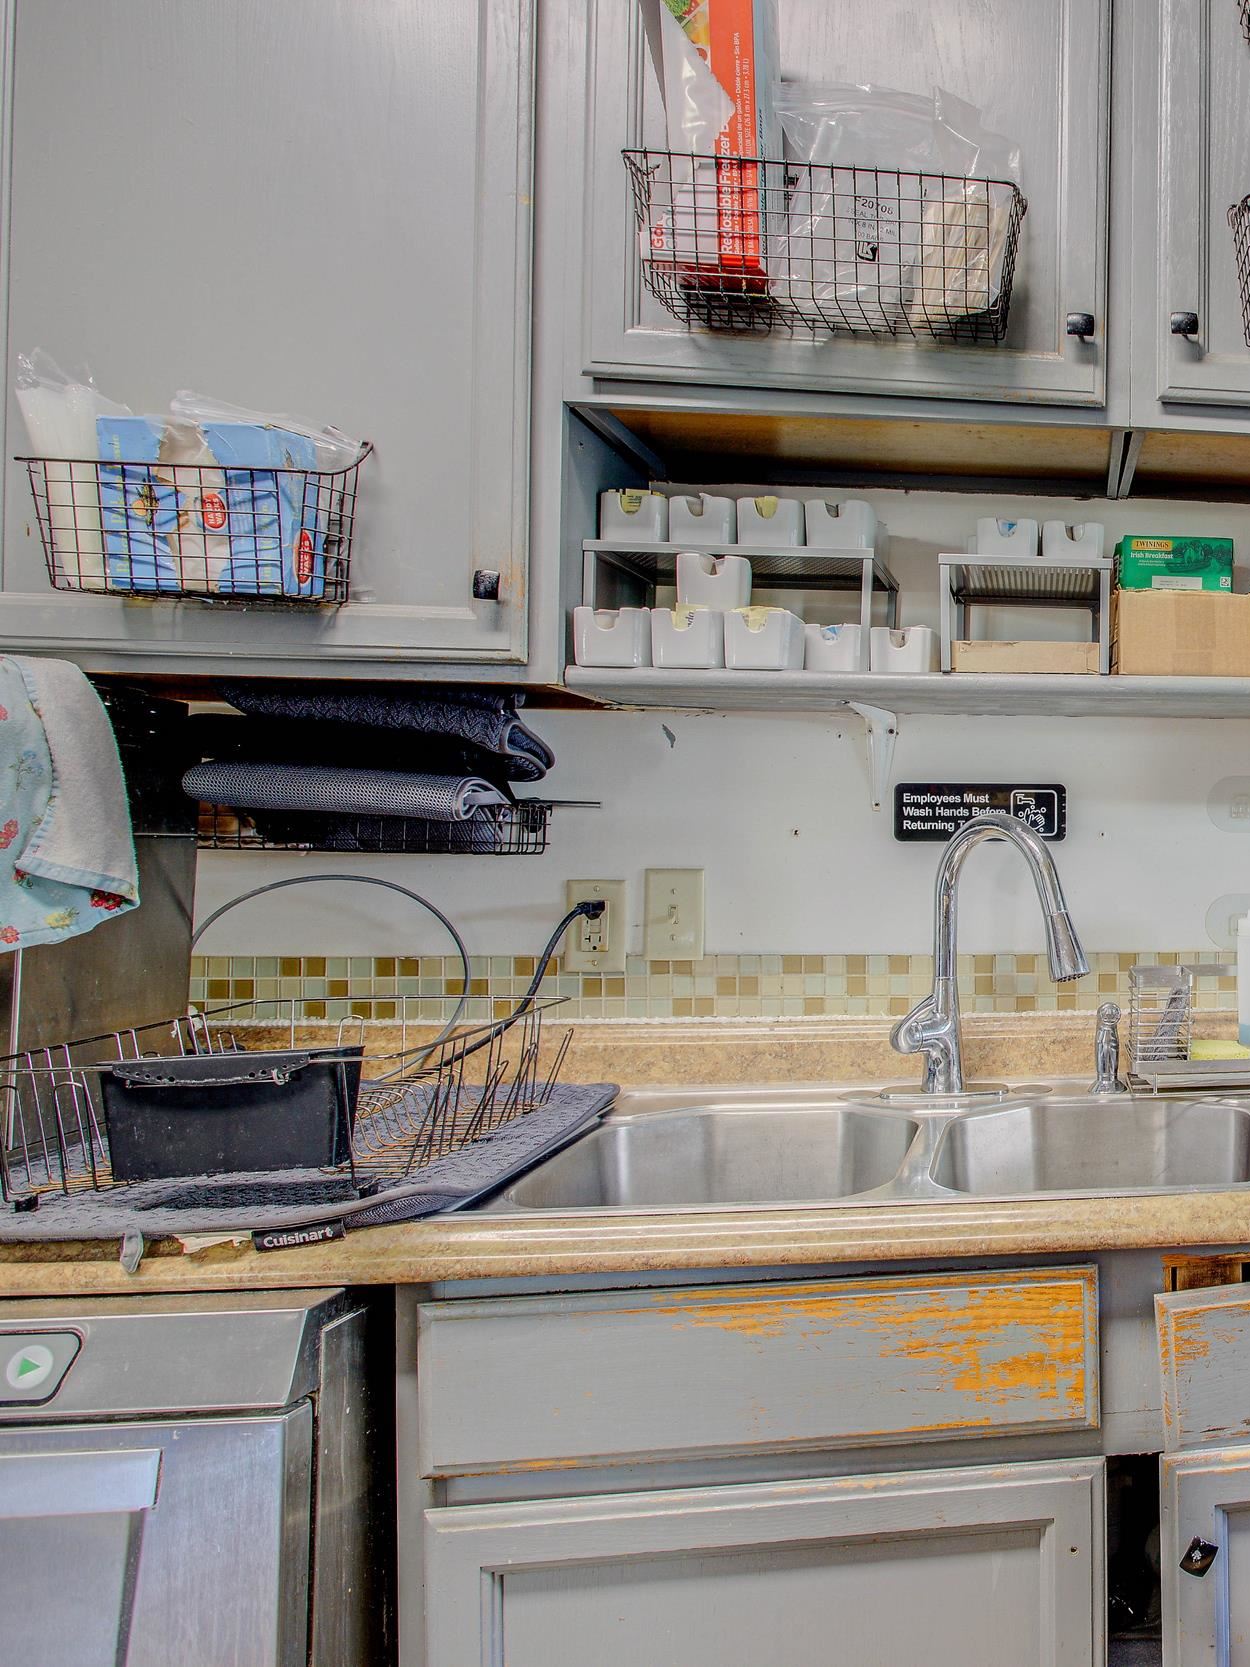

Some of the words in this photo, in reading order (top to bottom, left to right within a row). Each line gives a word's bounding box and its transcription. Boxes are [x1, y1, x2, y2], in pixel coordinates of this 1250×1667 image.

[719, 135, 731, 184] Freezer
[719, 187, 732, 254] Reclosable
[1135, 540, 1169, 548] TWININGS
[903, 793, 961, 805] Employees
[963, 793, 990, 803] Must
[903, 807, 934, 817] Wash
[935, 806, 969, 817] Hands
[971, 807, 1006, 816] Before
[903, 820, 955, 832] Returning
[263, 1226, 334, 1248] Cuisinart
